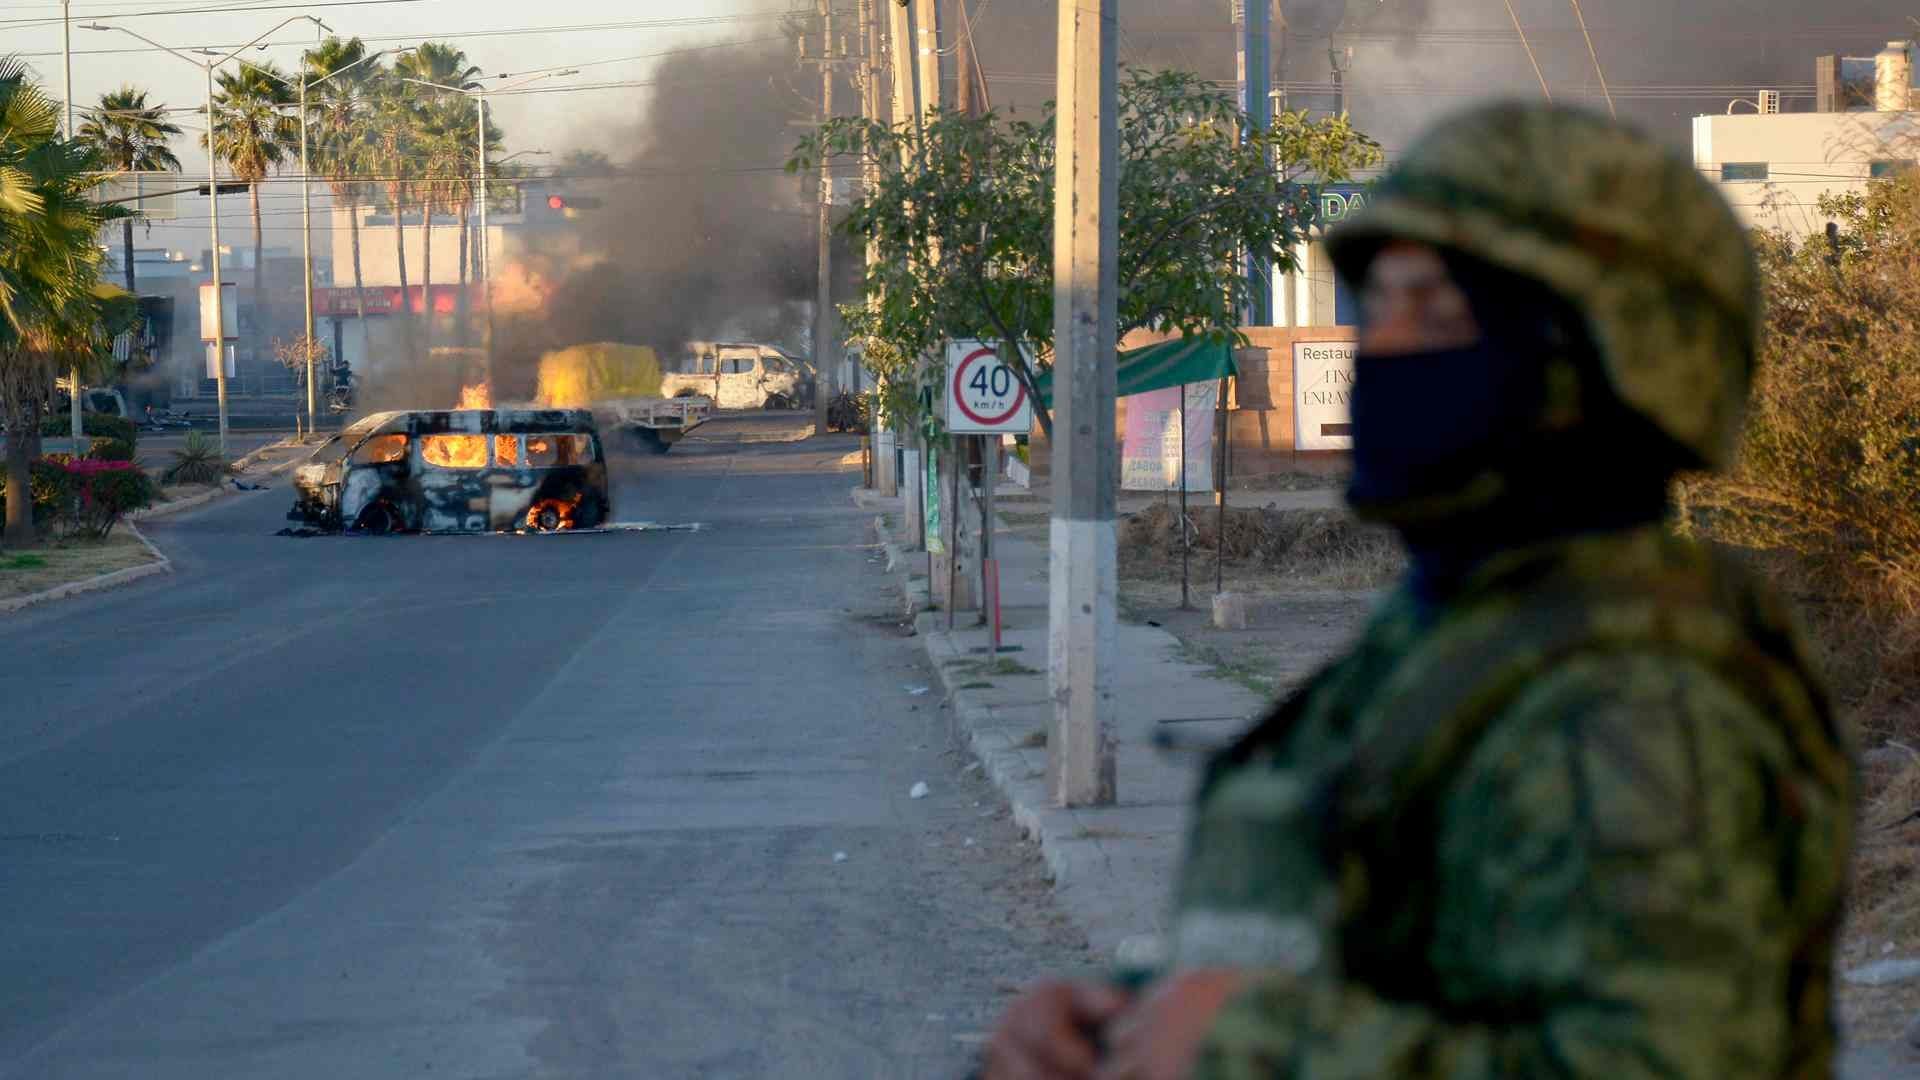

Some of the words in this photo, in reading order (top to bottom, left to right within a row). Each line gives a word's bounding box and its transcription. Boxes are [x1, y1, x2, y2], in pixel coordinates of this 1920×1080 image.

[1303, 347, 1353, 360] Restau
[969, 365, 1010, 397] 40
[974, 401, 1005, 409] km/h
